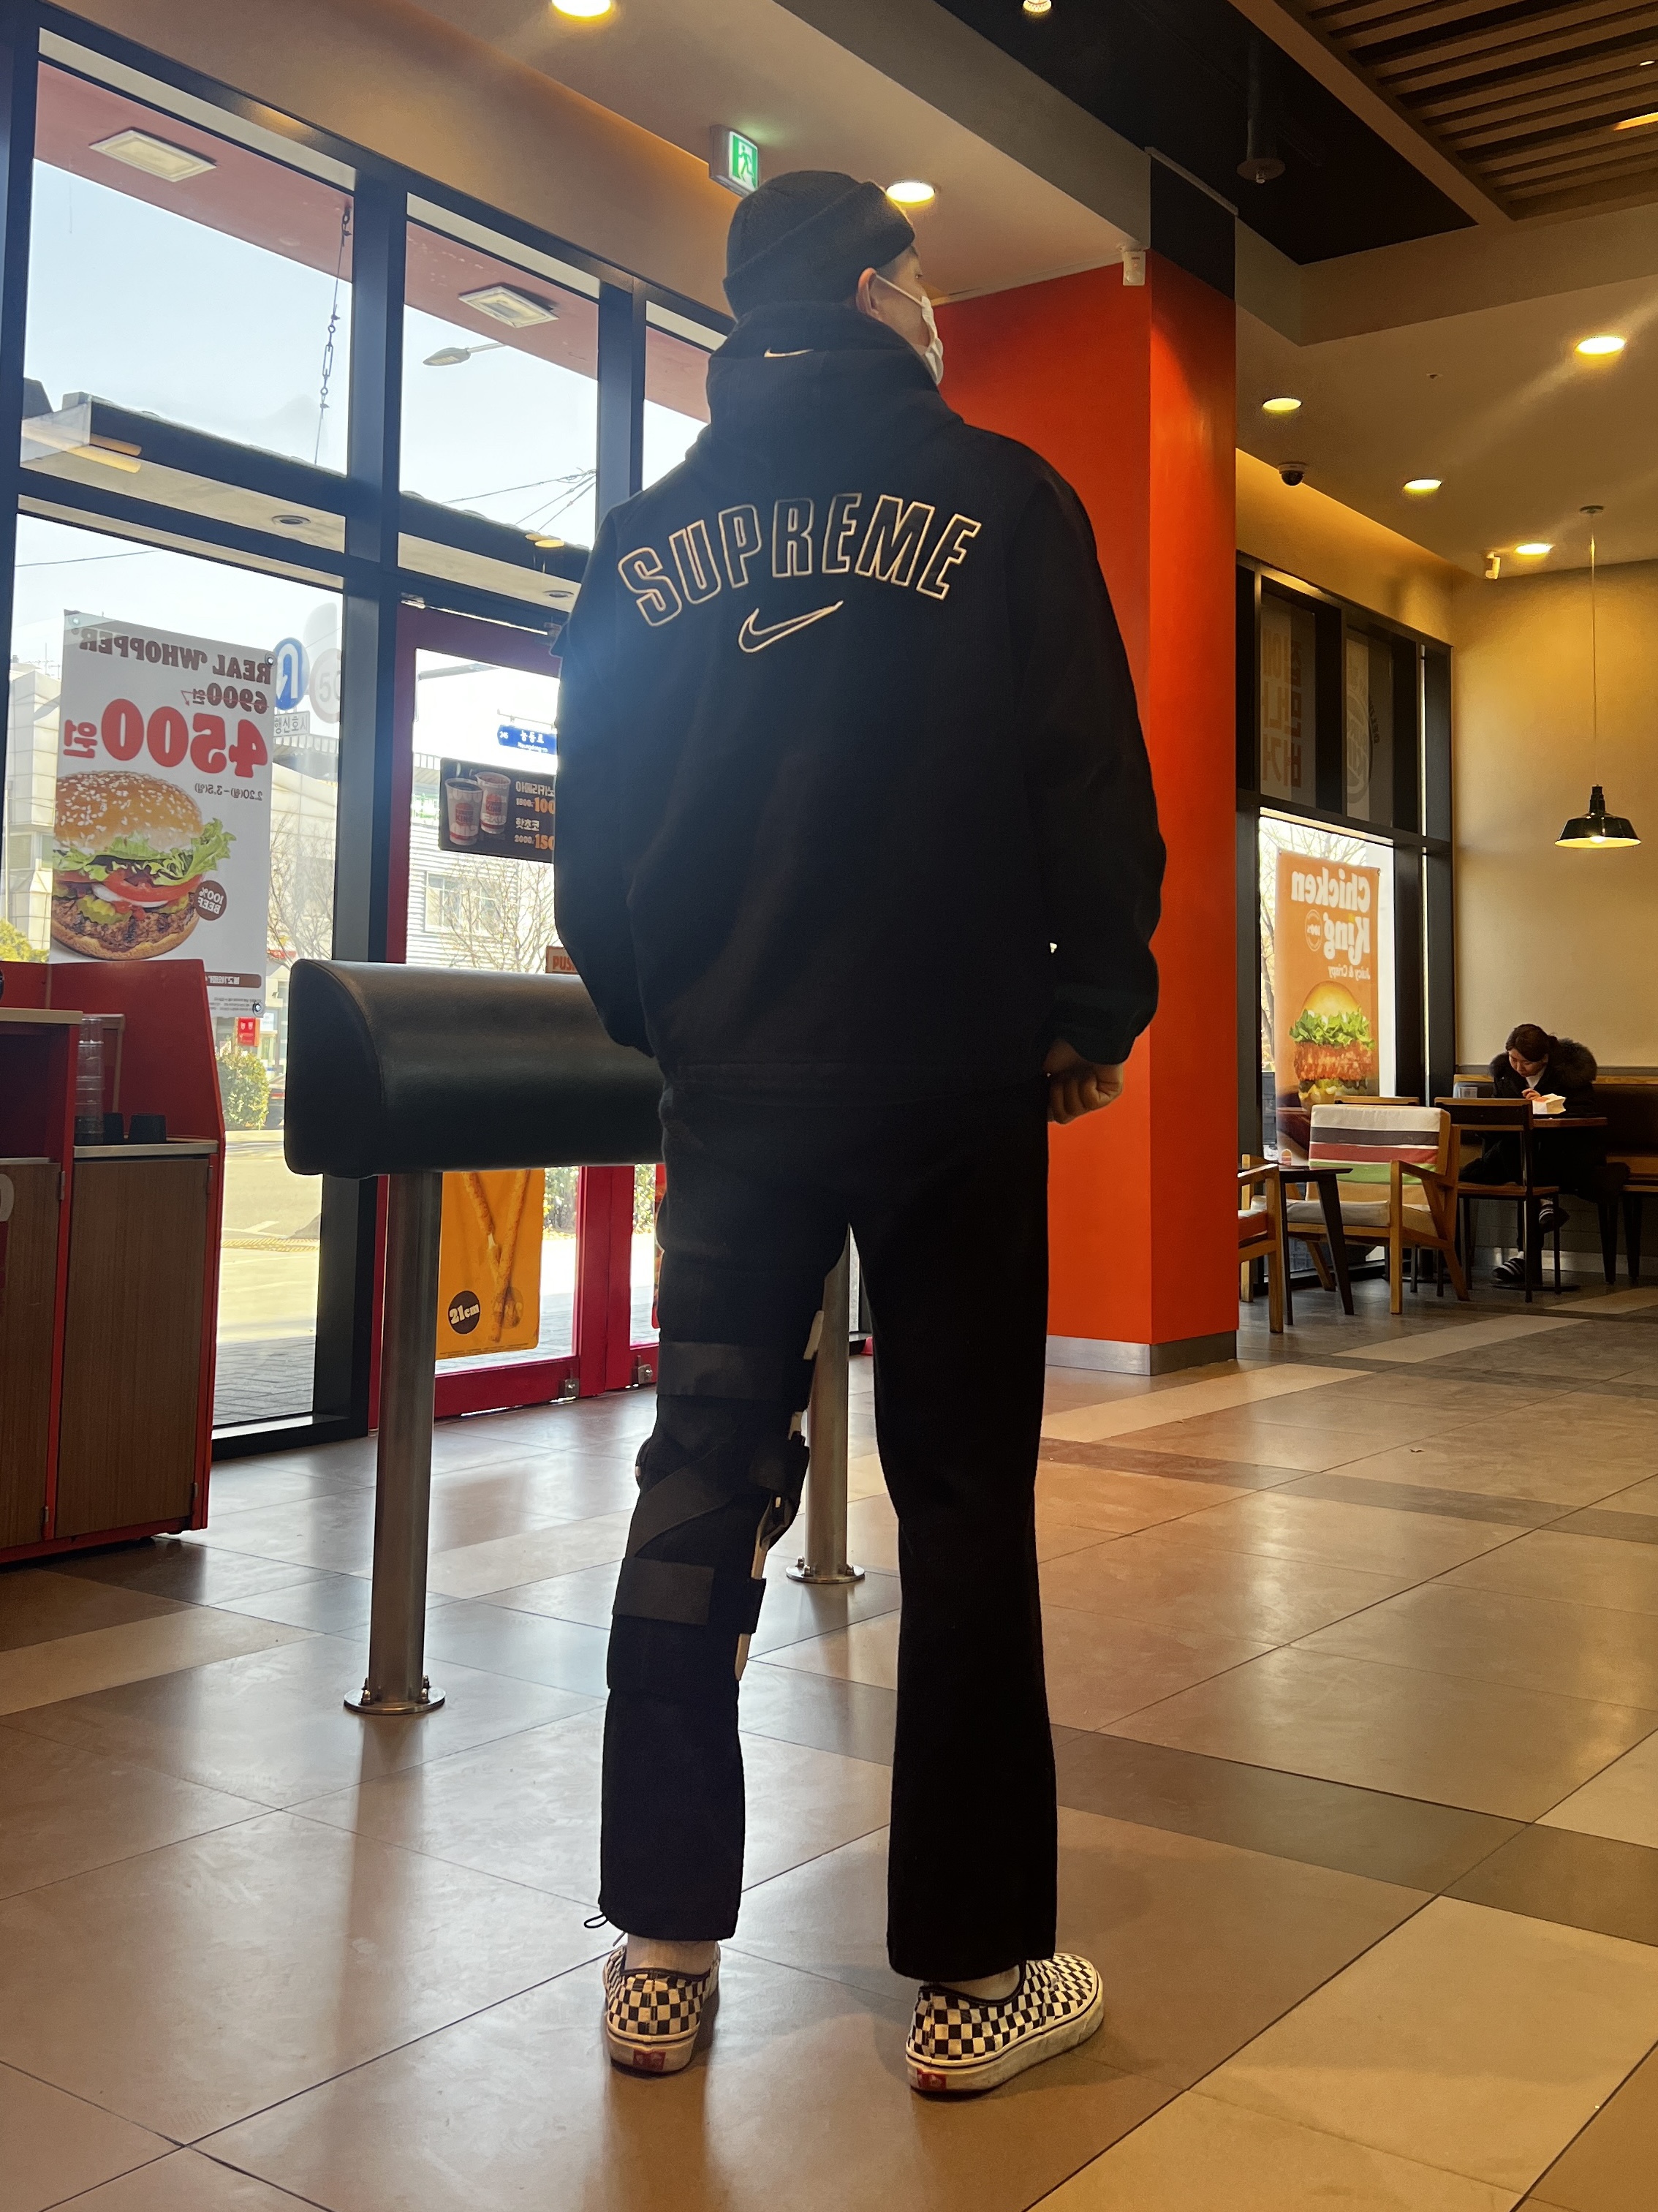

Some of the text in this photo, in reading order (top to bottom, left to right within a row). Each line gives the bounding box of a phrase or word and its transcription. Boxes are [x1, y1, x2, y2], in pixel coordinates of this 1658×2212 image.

[618, 493, 982, 627] SUPREME
[520, 730, 545, 744] 능동로
[515, 818, 540, 831] 핫초코
[553, 956, 575, 971] PUS
[449, 1304, 480, 1324] 21cm
